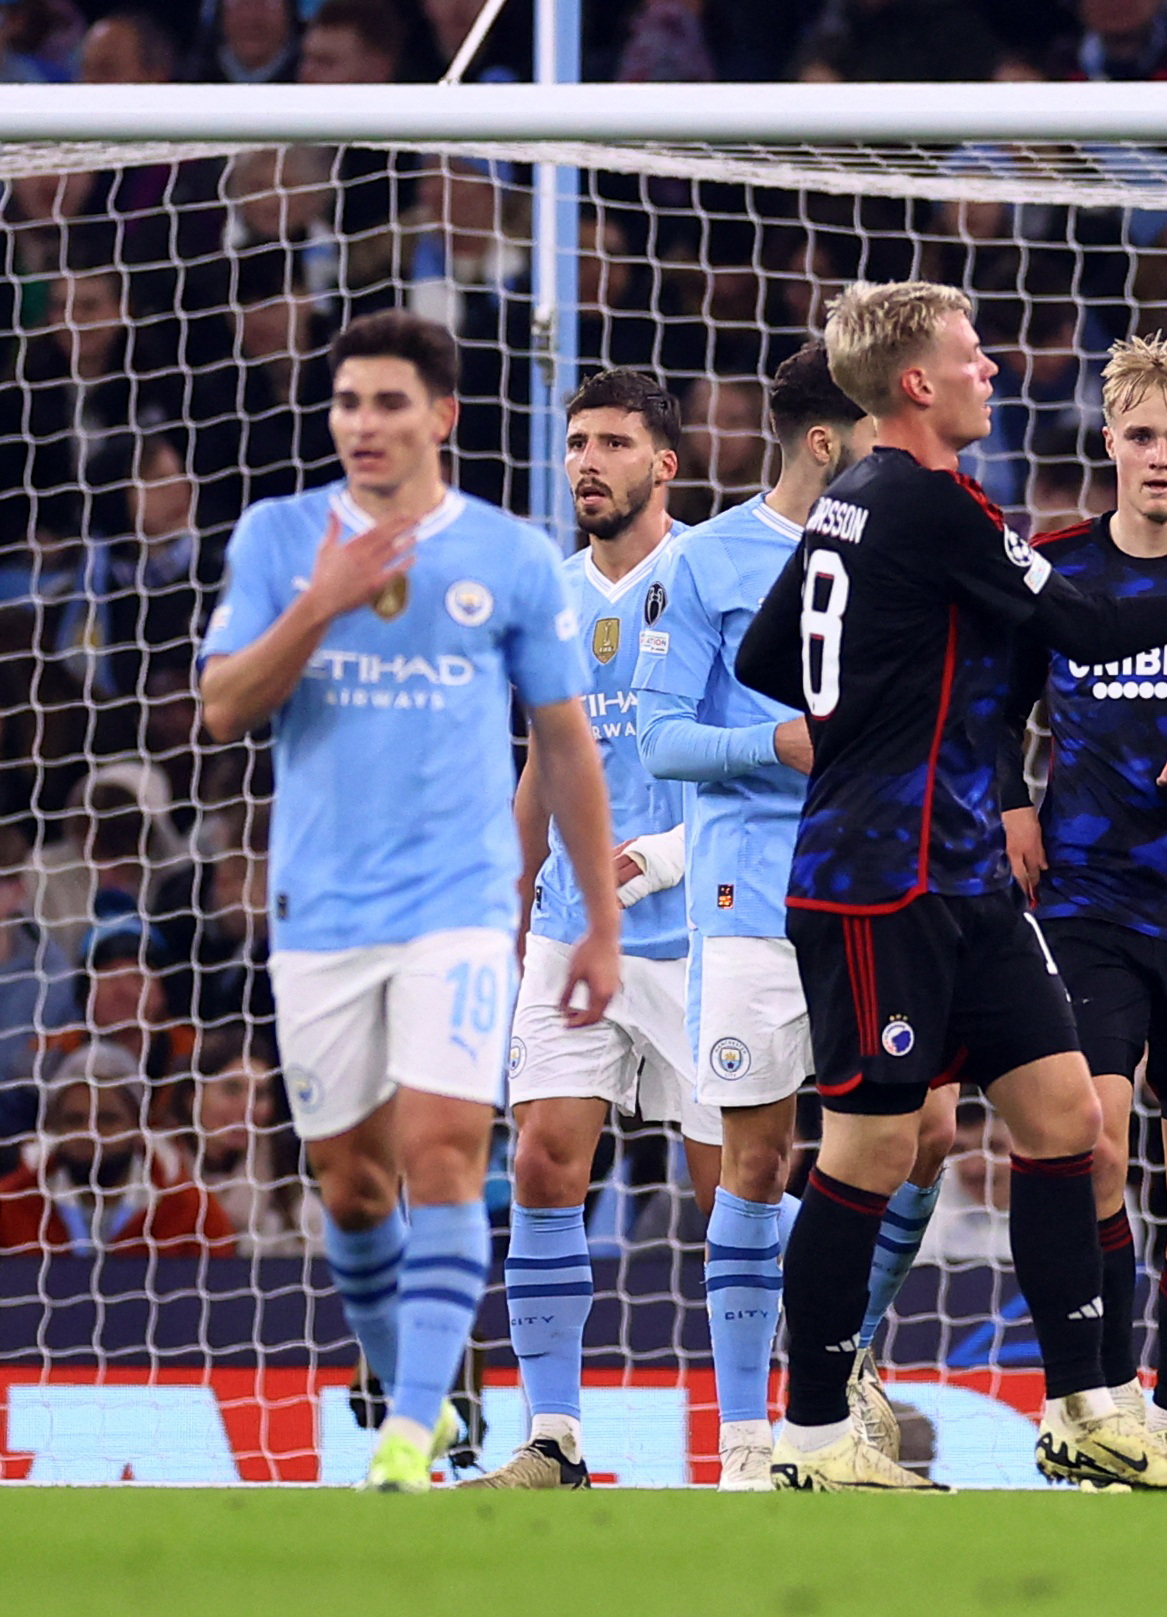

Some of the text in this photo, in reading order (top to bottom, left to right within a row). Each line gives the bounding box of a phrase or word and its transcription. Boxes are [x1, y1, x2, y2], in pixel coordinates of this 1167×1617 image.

[805, 496, 869, 544] RSSON
[801, 548, 850, 720] 8
[446, 962, 498, 1033] 19
[511, 1315, 555, 1326] CITY
[724, 1310, 768, 1320] CITY
